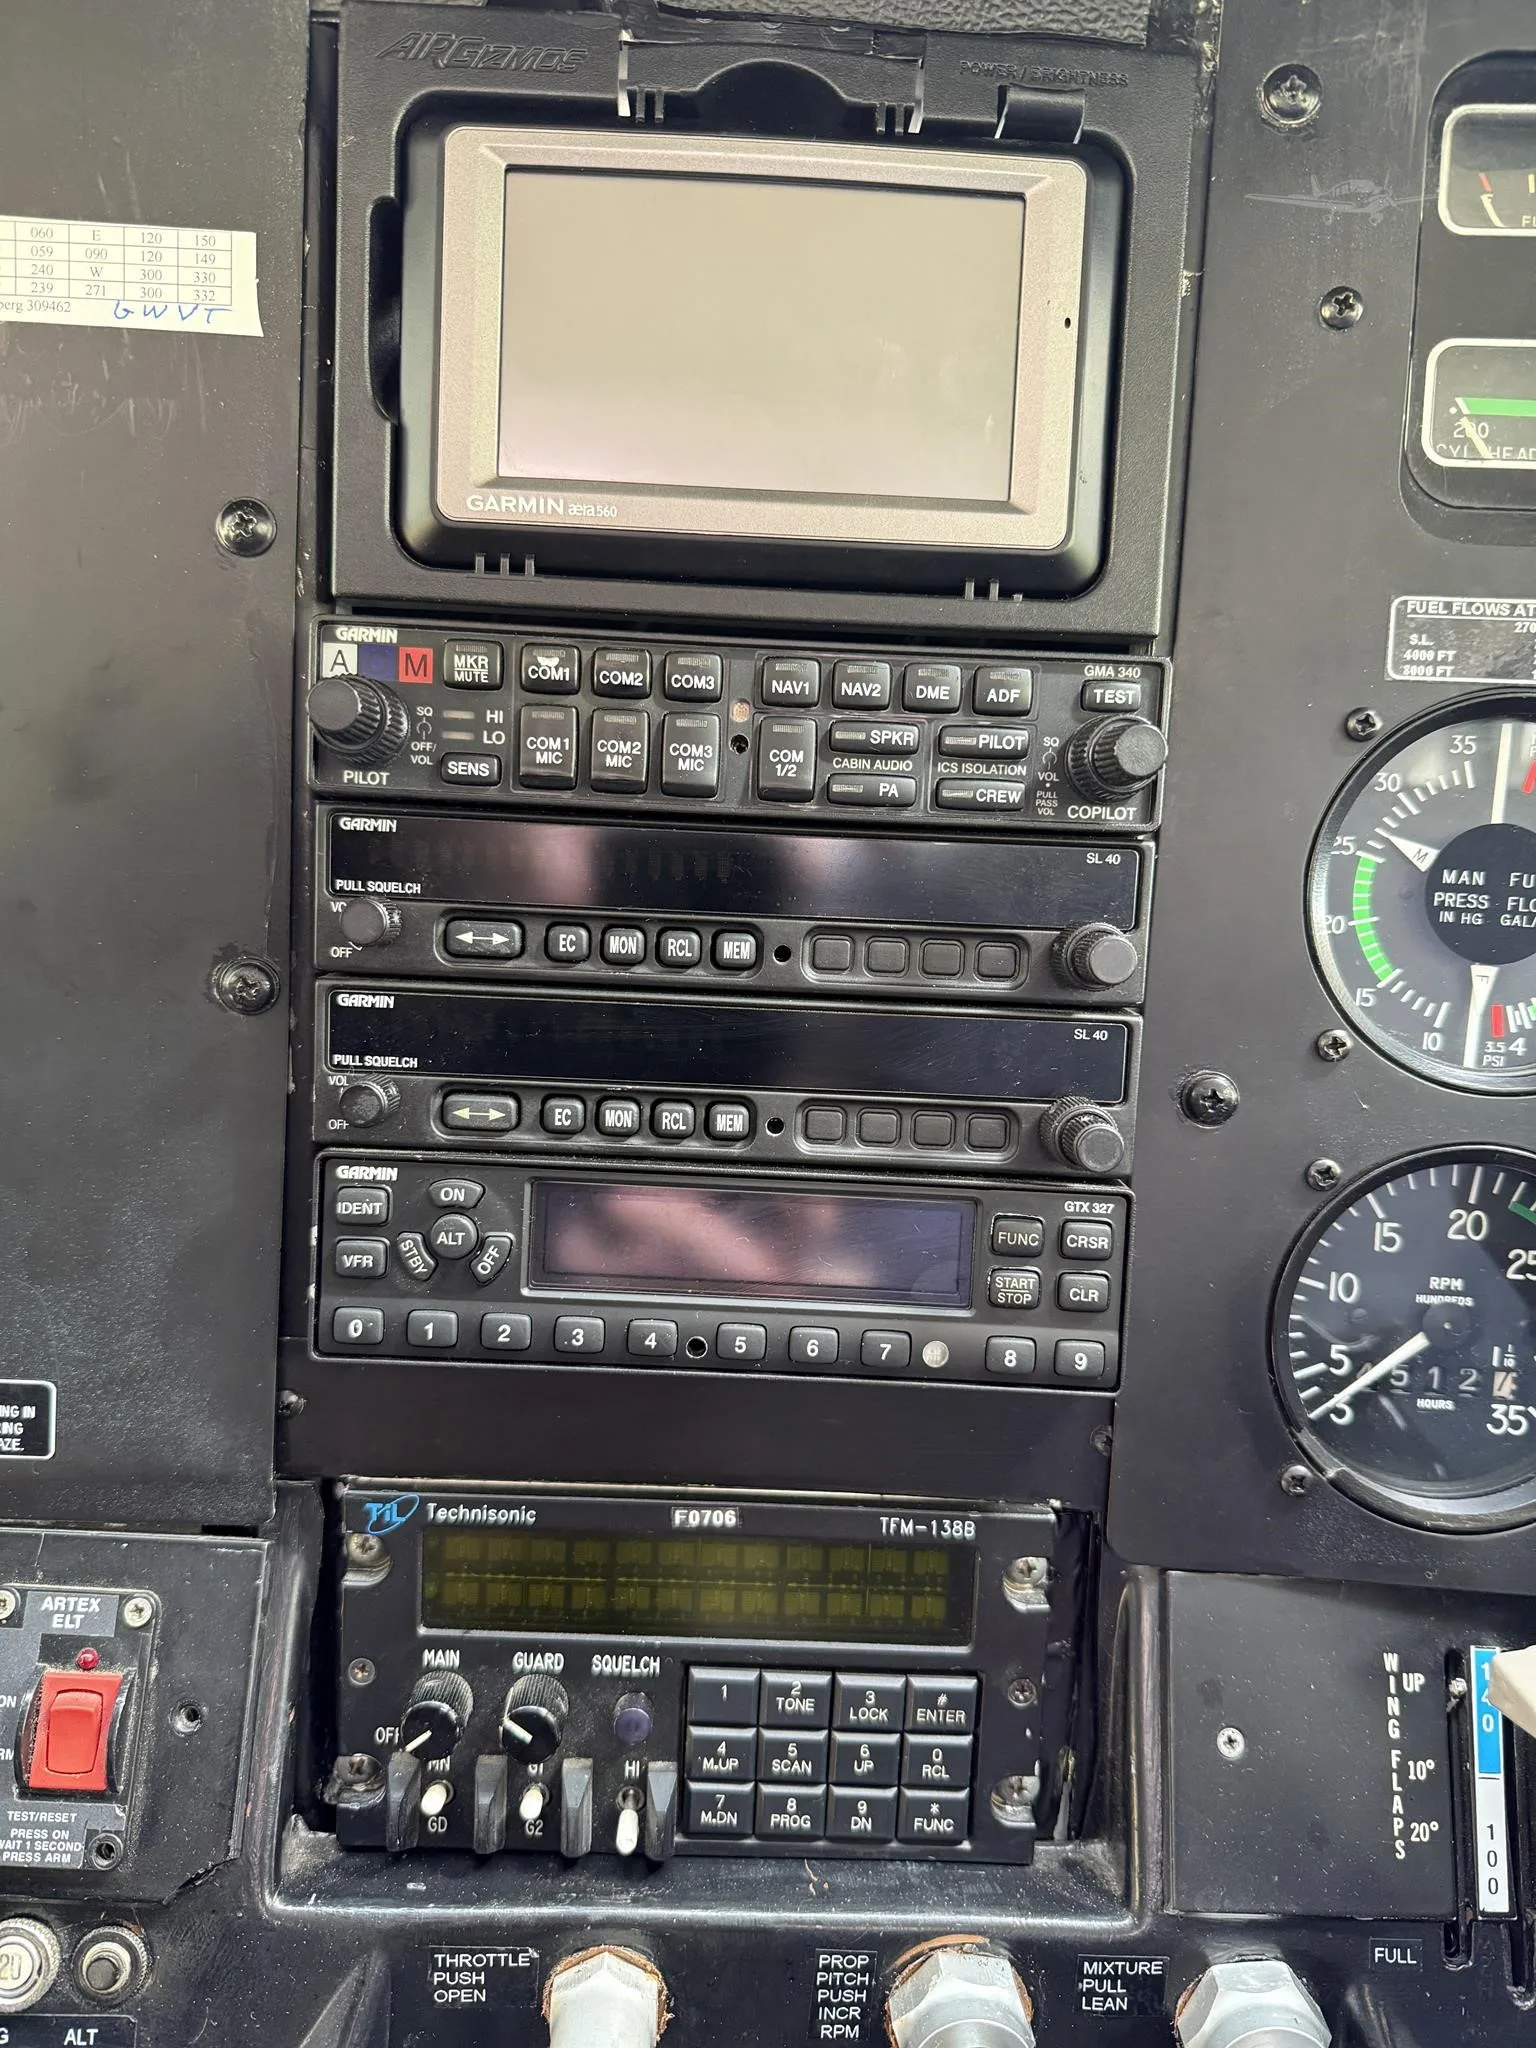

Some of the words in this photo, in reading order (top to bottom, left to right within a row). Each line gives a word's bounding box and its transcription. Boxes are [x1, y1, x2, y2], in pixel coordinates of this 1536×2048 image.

[960, 60, 1017, 78] POWER
[1031, 66, 1129, 88] BRIGHTNESS
[30, 227, 54, 239] 060
[141, 232, 162, 244] 120
[195, 235, 216, 247] 150
[30, 245, 54, 257] 059
[85, 248, 108, 260] 090
[195, 253, 216, 265] 149
[31, 263, 54, 276] 240
[139, 269, 162, 281] 300
[193, 271, 216, 284] 330
[31, 281, 54, 293] 239
[85, 284, 105, 296] 271
[193, 290, 216, 302] 332
[27, 300, 71, 313] 309462
[466, 495, 564, 515] GARMIN
[1407, 600, 1448, 614] FUEL
[1452, 602, 1511, 616] FLOWS
[1513, 604, 1536, 617] AT
[336, 627, 398, 643] GARMIN
[454, 655, 488, 669] MKR
[1437, 650, 1457, 662] FT
[454, 671, 488, 683] MUTE
[528, 665, 570, 682] COM1
[1084, 665, 1115, 677] GMA
[1118, 667, 1141, 679] 340
[1436, 665, 1455, 677] FT
[599, 671, 644, 687] COM2
[671, 675, 715, 690] COM3
[771, 680, 810, 695] NAV1
[841, 682, 882, 697] NAV2
[916, 686, 951, 700] DME
[986, 688, 1021, 703] ADF
[1093, 689, 1136, 705] TEST
[870, 731, 914, 746] SPKR
[978, 735, 1026, 751] PILOT
[1449, 735, 1479, 754] 35
[597, 740, 642, 755] COM2
[669, 744, 713, 758] COM3
[535, 752, 563, 764] MIC
[605, 756, 633, 768] MIC
[769, 750, 804, 763] COM
[447, 761, 490, 777] SENS
[678, 759, 705, 771] MIC
[775, 764, 797, 777] 1/2
[832, 757, 871, 770] CABIN
[873, 758, 913, 771] AUDIO
[937, 762, 958, 774] ICS
[961, 763, 1027, 776] ISOLATION
[343, 771, 390, 785] PILOT
[1038, 772, 1059, 782] VOL
[1374, 772, 1401, 792] 30
[975, 789, 1022, 804] CREW
[1067, 806, 1137, 821] COPILOT
[339, 817, 397, 832] GARMIN
[1086, 853, 1103, 864] SL
[1105, 854, 1121, 865] 40
[1442, 869, 1486, 886] MAN
[335, 879, 365, 891] PULL
[367, 881, 421, 894] SQUELCH
[1433, 891, 1490, 909] PRESS
[1439, 911, 1455, 923] IN
[1461, 912, 1484, 925] HG
[559, 934, 576, 952] EC
[609, 936, 637, 955] MON
[667, 938, 693, 957] RCL
[723, 941, 750, 960] MEM
[337, 994, 394, 1009] GARMIN
[1355, 988, 1377, 1007] 15
[1074, 1029, 1090, 1040] SL
[1092, 1029, 1108, 1041] 40
[1423, 1032, 1443, 1050] 10
[333, 1055, 363, 1066] PULL
[364, 1056, 418, 1068] SQUELCH
[1482, 1054, 1505, 1066] PSI
[554, 1109, 572, 1126] EC
[605, 1110, 632, 1128] MON
[662, 1112, 686, 1130] RCL
[716, 1114, 743, 1132] MEM
[336, 1166, 398, 1181] GARMIN
[440, 1188, 465, 1202] ON
[337, 1201, 383, 1215] IDENT
[1064, 1201, 1090, 1213] GTX
[1092, 1202, 1115, 1214] 327
[1447, 1209, 1488, 1241] 20
[436, 1232, 466, 1246] ALT
[998, 1232, 1039, 1246] FUNC
[1066, 1235, 1109, 1250] CRSR
[1374, 1222, 1402, 1252] 15
[342, 1255, 374, 1269] VFR
[401, 1239, 428, 1276] STBY
[477, 1245, 501, 1275] OFF
[995, 1277, 1035, 1290] START
[1329, 1271, 1359, 1303] 10
[1429, 1276, 1464, 1290] RPM
[997, 1292, 1032, 1304] STOP
[1069, 1288, 1099, 1302] CLR
[1417, 1398, 1455, 1411] HOURS
[1486, 1404, 1530, 1436] 35
[426, 1502, 536, 1525] Technisonic
[880, 1516, 976, 1540] TFM-138B
[41, 1596, 101, 1613] ARTEX
[52, 1614, 85, 1629] ELT
[423, 1650, 460, 1669] MAIN
[512, 1651, 565, 1673] GUARD
[592, 1655, 660, 1676] SQUELCH
[1403, 1672, 1425, 1692] UP
[777, 1698, 815, 1713] TONE
[850, 1707, 888, 1722] LOCK
[917, 1709, 966, 1725] ENTER
[703, 1757, 738, 1771] M.UP
[772, 1759, 812, 1774] SCAN
[854, 1760, 874, 1774] UP
[922, 1764, 949, 1779] RCL
[7, 1811, 77, 1823] TEST/RESET
[701, 1811, 738, 1825] M.DN
[770, 1814, 811, 1830] PROG
[914, 1817, 954, 1832] FUNC
[11, 1828, 48, 1840] PRESS
[52, 1829, 70, 1840] ON
[26, 1841, 30, 1850] 1
[34, 1841, 82, 1852] SECOND
[3, 1851, 41, 1862] PRESS
[45, 1853, 71, 1863] ARM
[434, 1953, 531, 1968] THROTTLE
[819, 1955, 870, 1969] PROP
[1375, 1947, 1417, 1964] FULL
[1083, 1961, 1164, 1976] MIXTURE
[433, 1972, 485, 1985] PUSH
[816, 1972, 869, 1986] PITCH
[1083, 1979, 1127, 1993] PULL
[434, 1989, 486, 2002] OPEN
[818, 1989, 867, 2003] PUSH
[1082, 1997, 1128, 2011] LEAN
[818, 2006, 861, 2020] INCR
[64, 2028, 98, 2046] ALT
[820, 2025, 860, 2039] RPM
